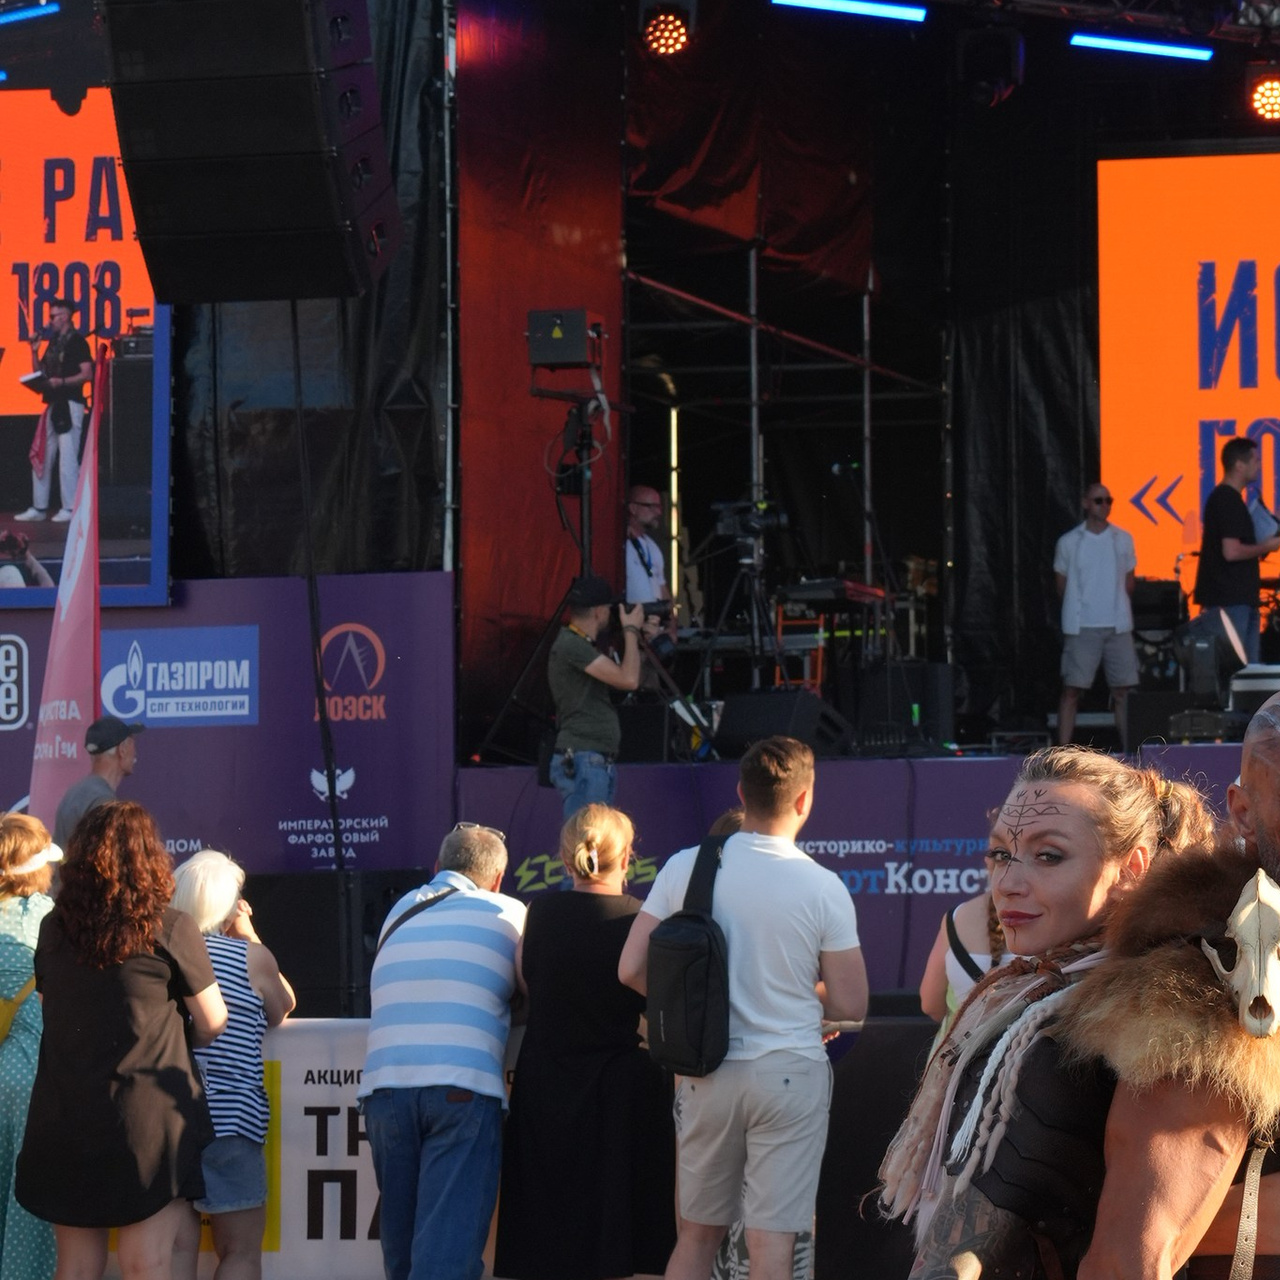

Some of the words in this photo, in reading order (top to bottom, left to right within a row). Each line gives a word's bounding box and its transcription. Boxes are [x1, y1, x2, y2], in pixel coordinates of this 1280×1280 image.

[146, 659, 249, 691] ГАЗПРОМ
[150, 701, 171, 713] СПГ
[176, 699, 246, 712] ТЕХНОЛОГИИ
[287, 830, 380, 845] ФАРФООВЫЙ
[311, 847, 357, 859] ЗАВД
